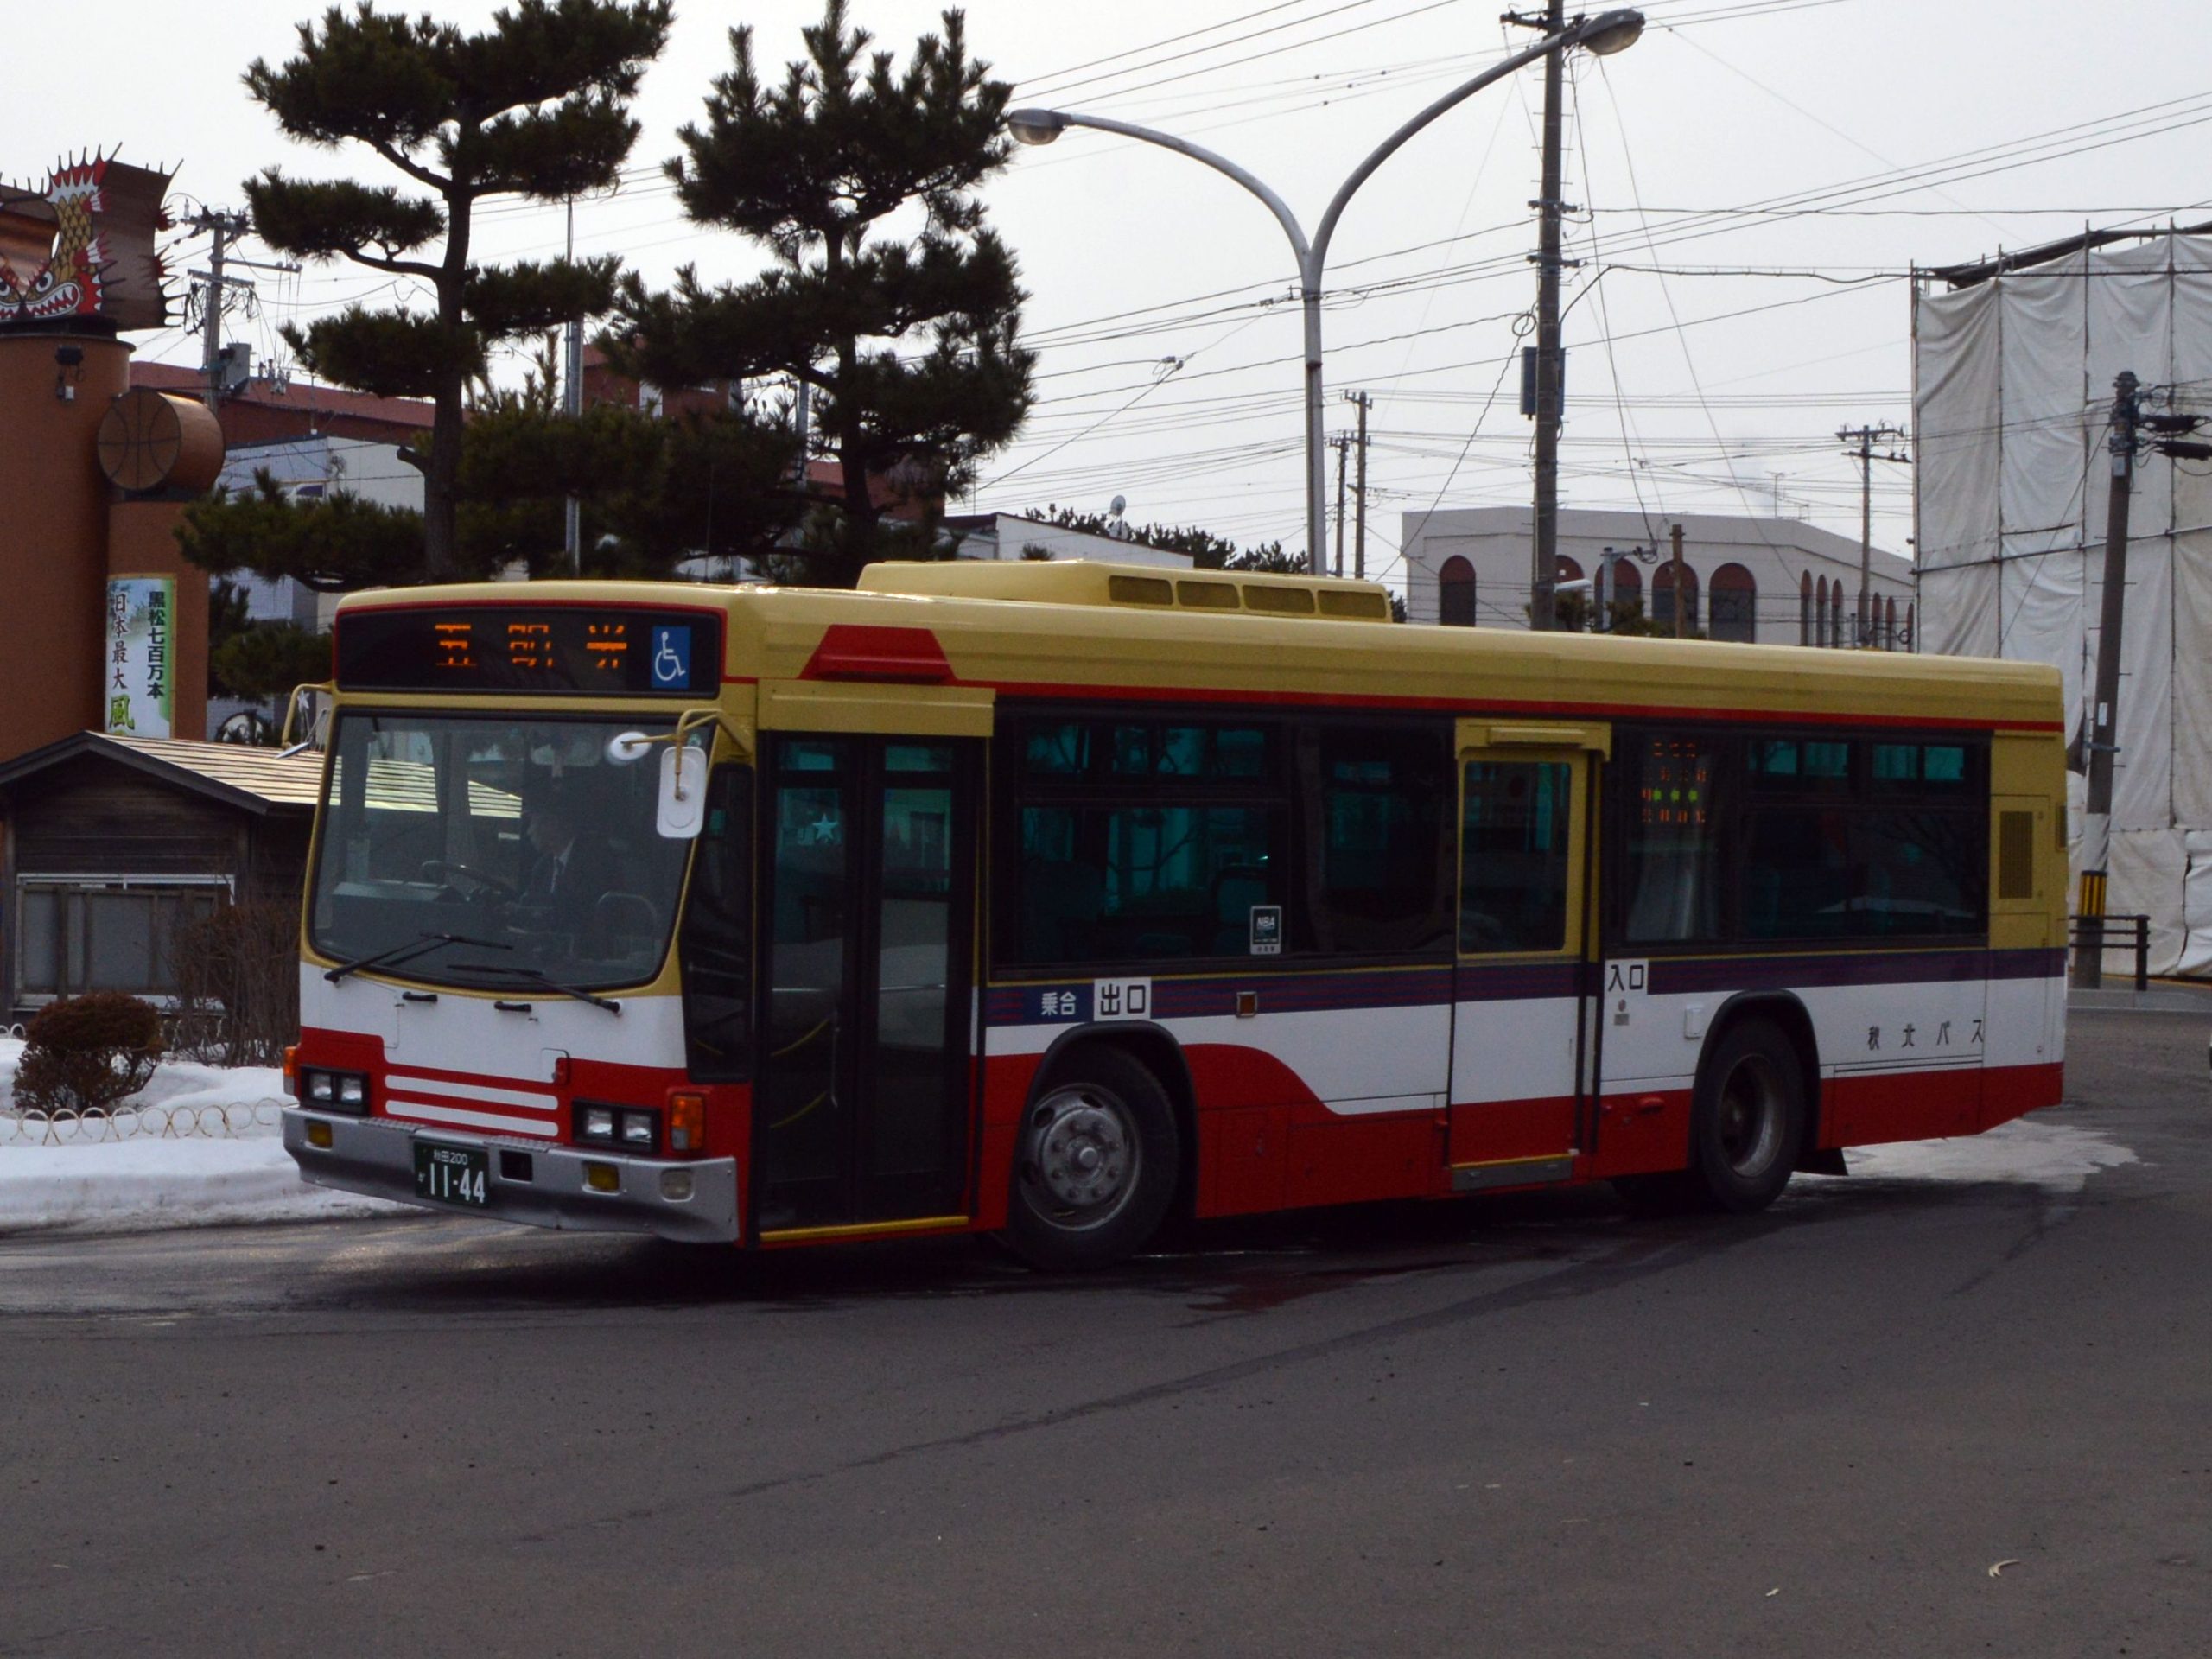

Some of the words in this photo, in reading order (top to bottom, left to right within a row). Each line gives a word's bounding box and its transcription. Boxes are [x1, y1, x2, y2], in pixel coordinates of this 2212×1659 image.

[111, 592, 130, 690] 日本最大
[147, 590, 167, 700] 黒松七百万本
[109, 692, 136, 735] 風
[1607, 963, 1645, 993] 入口
[1040, 991, 1077, 1016] 乗合
[1099, 982, 1147, 1016] 出口
